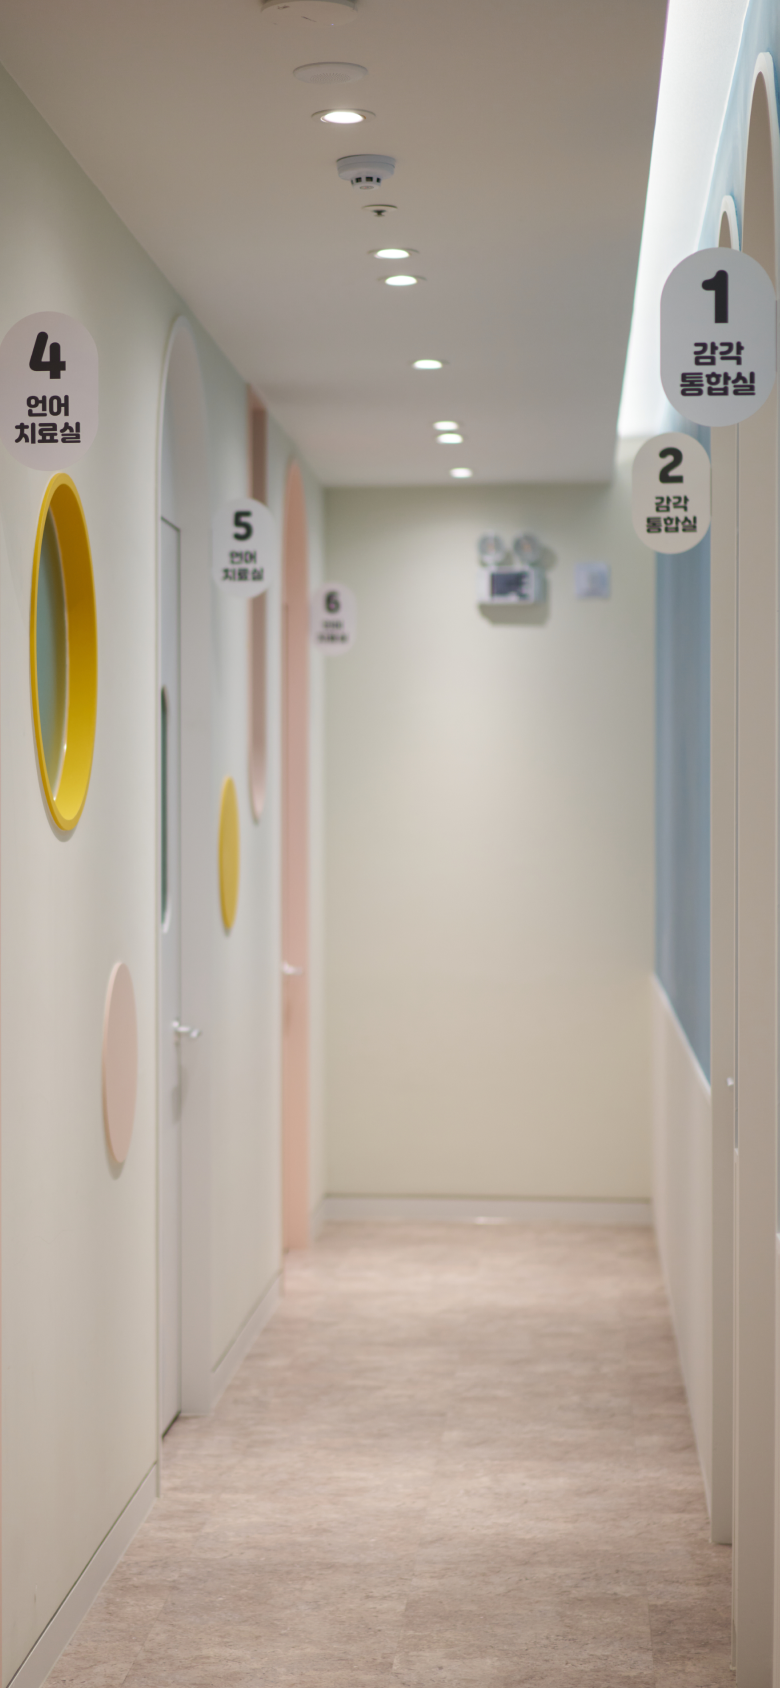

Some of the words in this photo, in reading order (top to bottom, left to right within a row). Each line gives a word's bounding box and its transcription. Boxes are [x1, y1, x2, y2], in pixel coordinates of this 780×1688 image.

[701, 269, 729, 324] 1
[28, 331, 66, 380] 4
[693, 341, 744, 366] 감각
[680, 371, 756, 397] 통합실
[26, 394, 70, 417] 언어
[14, 421, 81, 444] 치료실
[658, 446, 684, 484] 2
[654, 495, 689, 513] 감각
[233, 510, 253, 541] 5
[646, 516, 697, 534] 통합실
[325, 590, 340, 614] 6
